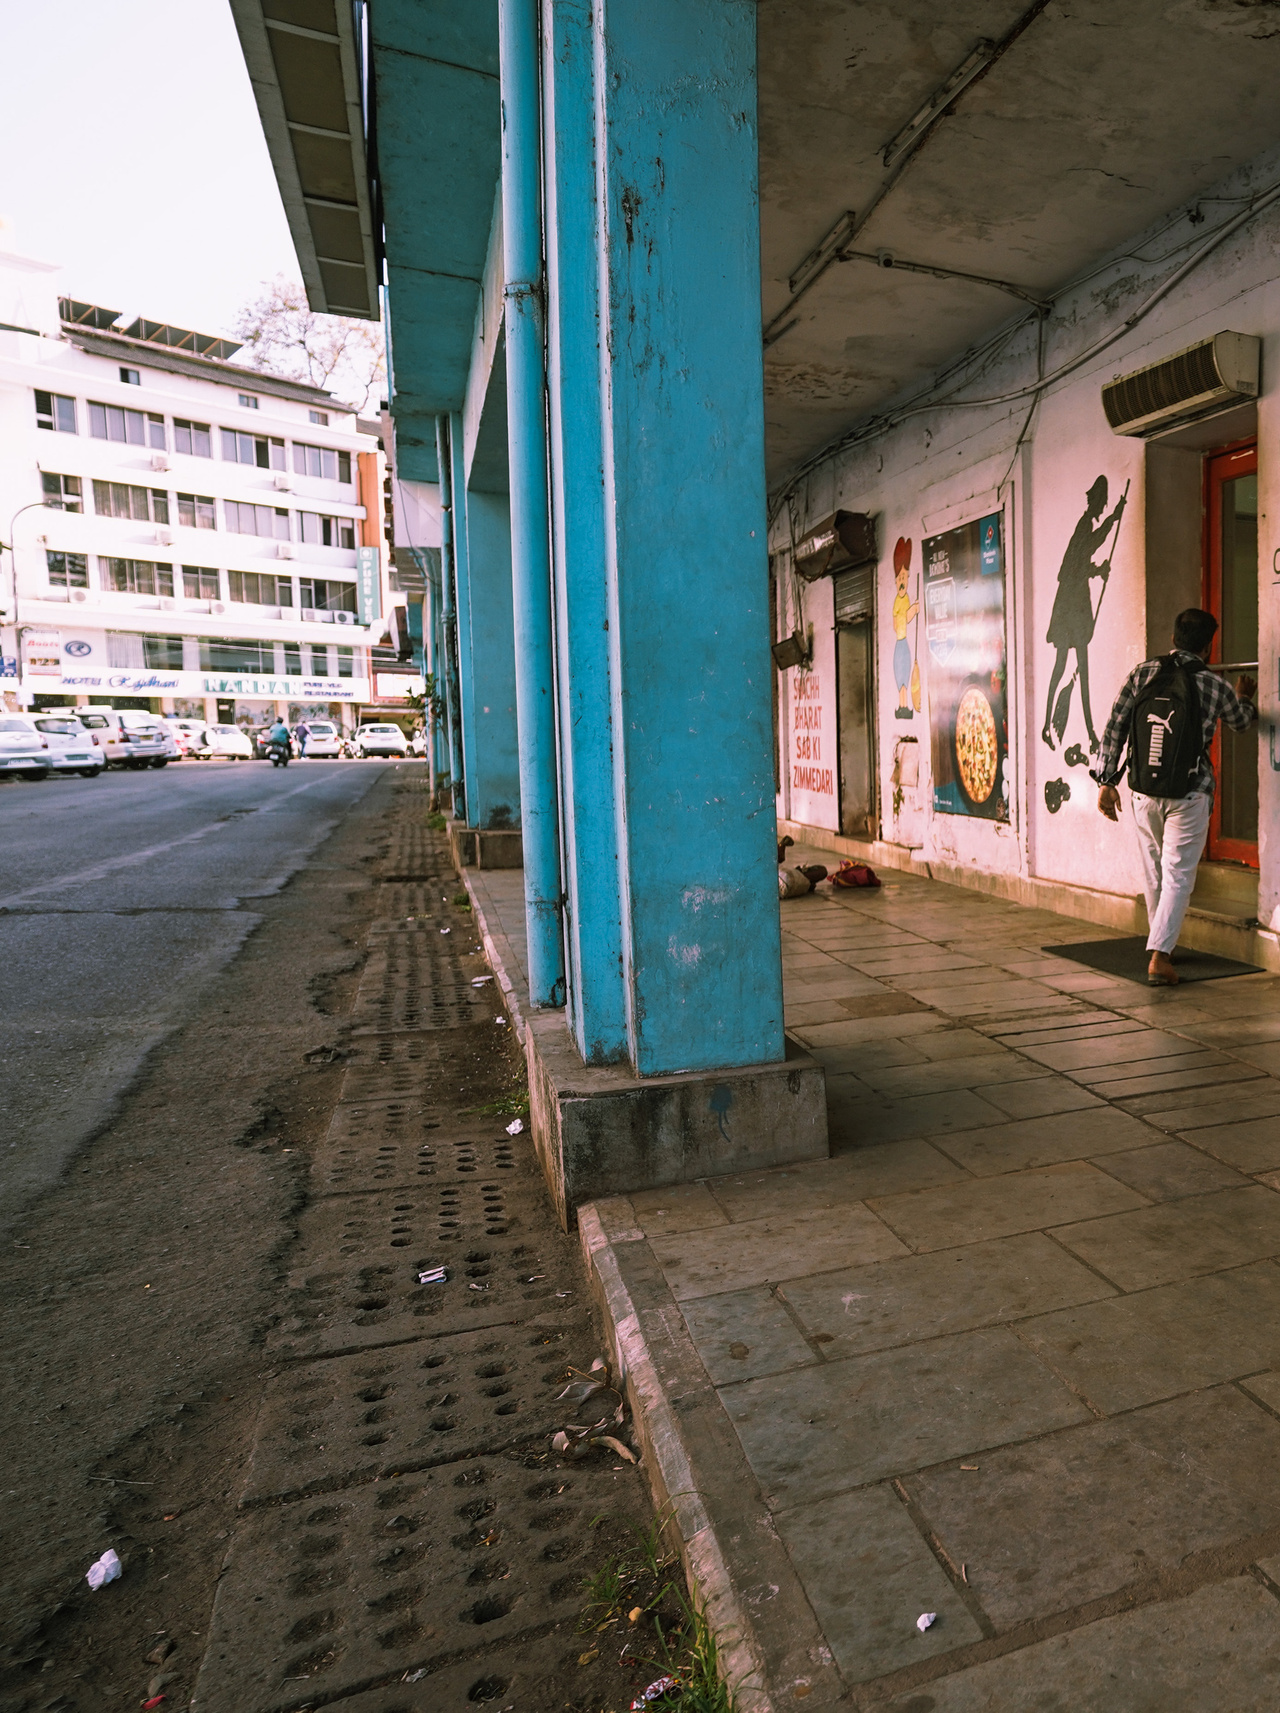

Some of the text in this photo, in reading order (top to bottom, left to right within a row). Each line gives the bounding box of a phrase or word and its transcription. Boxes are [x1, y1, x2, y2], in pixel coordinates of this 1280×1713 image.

[363, 561, 374, 624] PURE VEG
[204, 679, 300, 695] NANDAN
[795, 706, 822, 730] BHARAT
[796, 735, 821, 761] SAB KI
[1148, 724, 1165, 767] PUMA
[793, 765, 834, 796] ZIMMEDARI
